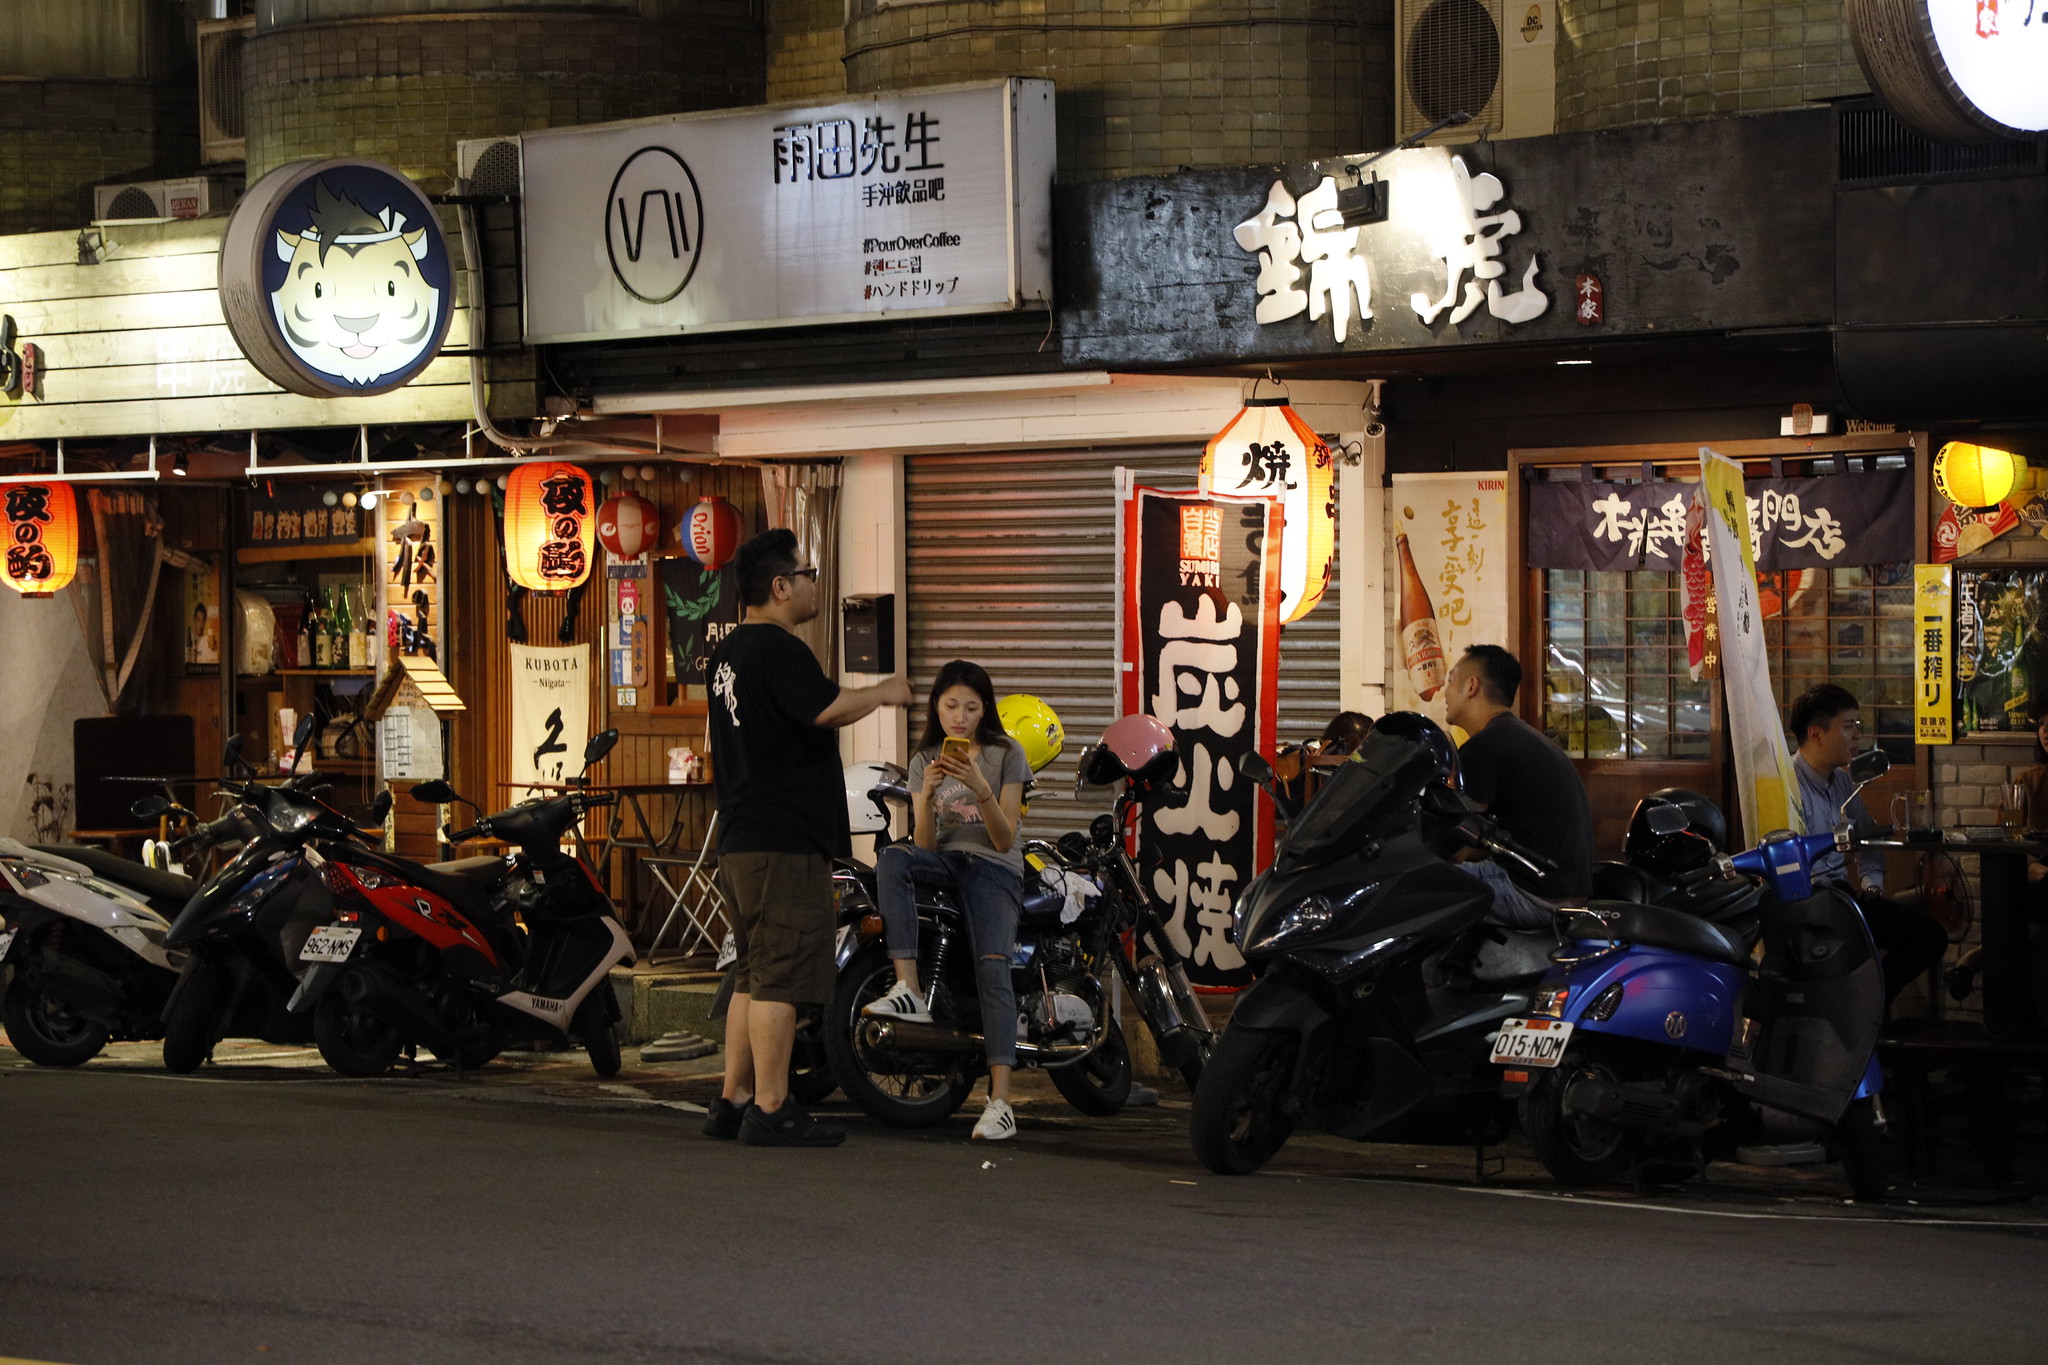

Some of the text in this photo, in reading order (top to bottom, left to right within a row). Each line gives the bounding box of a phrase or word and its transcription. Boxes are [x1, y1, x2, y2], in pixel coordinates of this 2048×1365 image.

[1526, 16, 1538, 25] DC
[773, 112, 944, 184] 雨田先生
[862, 177, 945, 207] 手沖飲品吧
[863, 231, 961, 253] #PourOverCoffee
[864, 277, 959, 299] #ハンドドリップ
[1580, 277, 1599, 319] 本家
[1846, 419, 1896, 433] Welcome
[1478, 480, 1504, 490] KIRIN
[1179, 559, 1220, 575] SUMIBI
[1179, 572, 1220, 589] YAKI
[525, 657, 578, 671] KUBOTA
[1923, 615, 1943, 708] 一番搾り
[539, 677, 565, 689] Niigata
[303, 936, 354, 956] 962-NMS
[531, 996, 559, 1013] YAMAHA
[1495, 1033, 1565, 1059] 015-NDM
